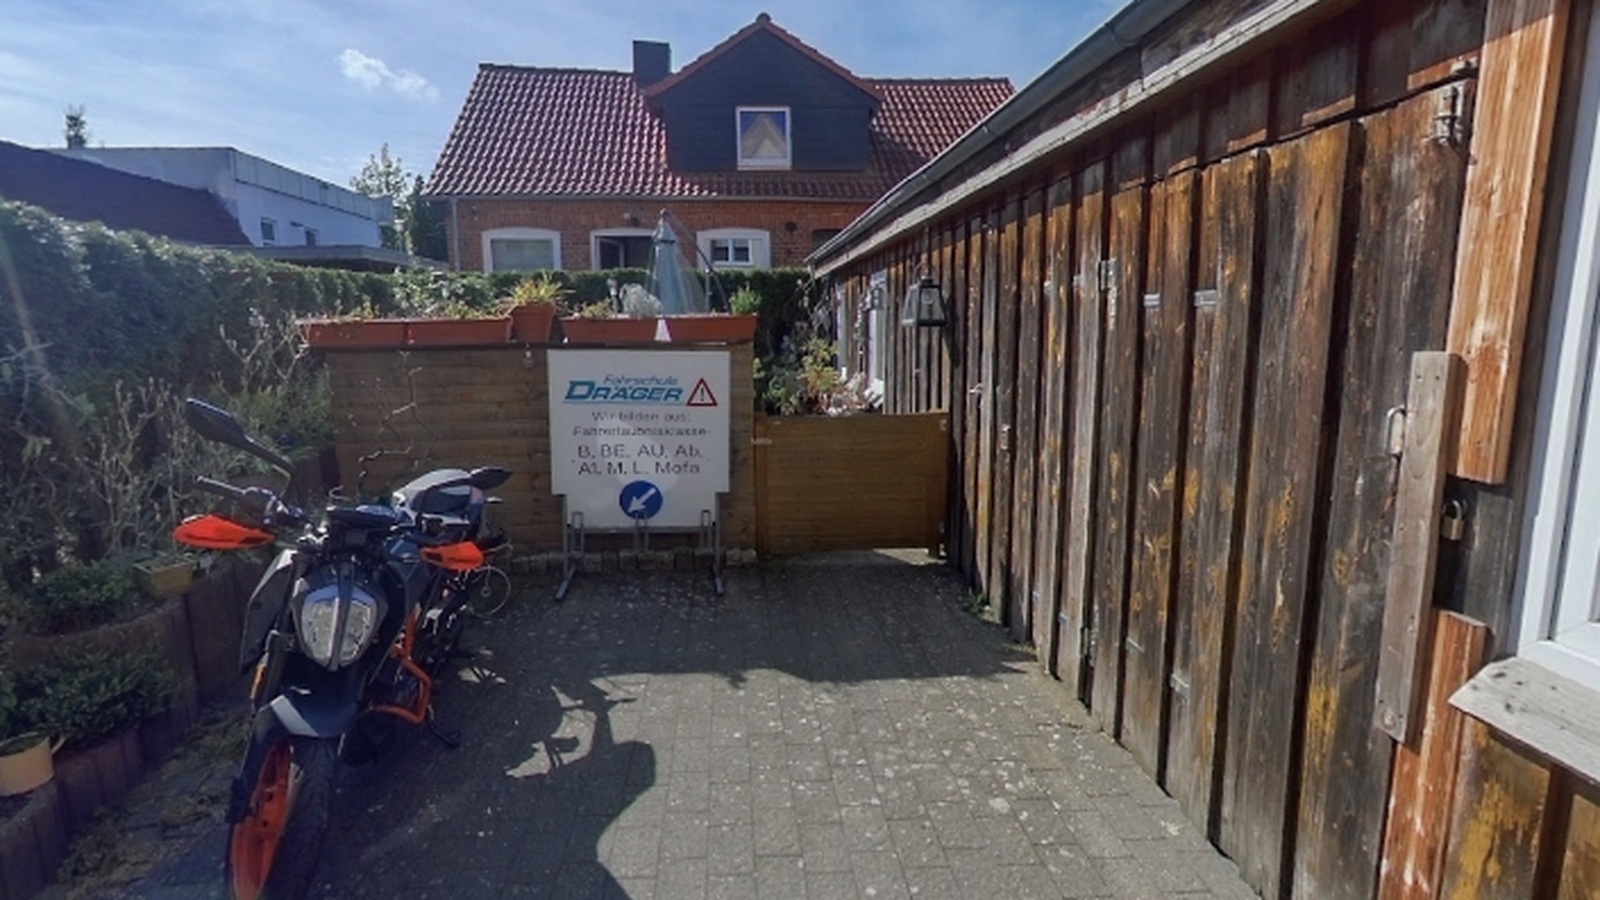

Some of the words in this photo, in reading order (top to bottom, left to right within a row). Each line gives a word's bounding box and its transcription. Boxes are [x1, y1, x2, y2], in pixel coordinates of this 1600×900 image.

[603, 374, 678, 385] Fahrschule
[564, 380, 683, 400] DRÄGER
[591, 411, 615, 422] Wir
[618, 411, 659, 422] bilden
[655, 461, 699, 474] Mofa
